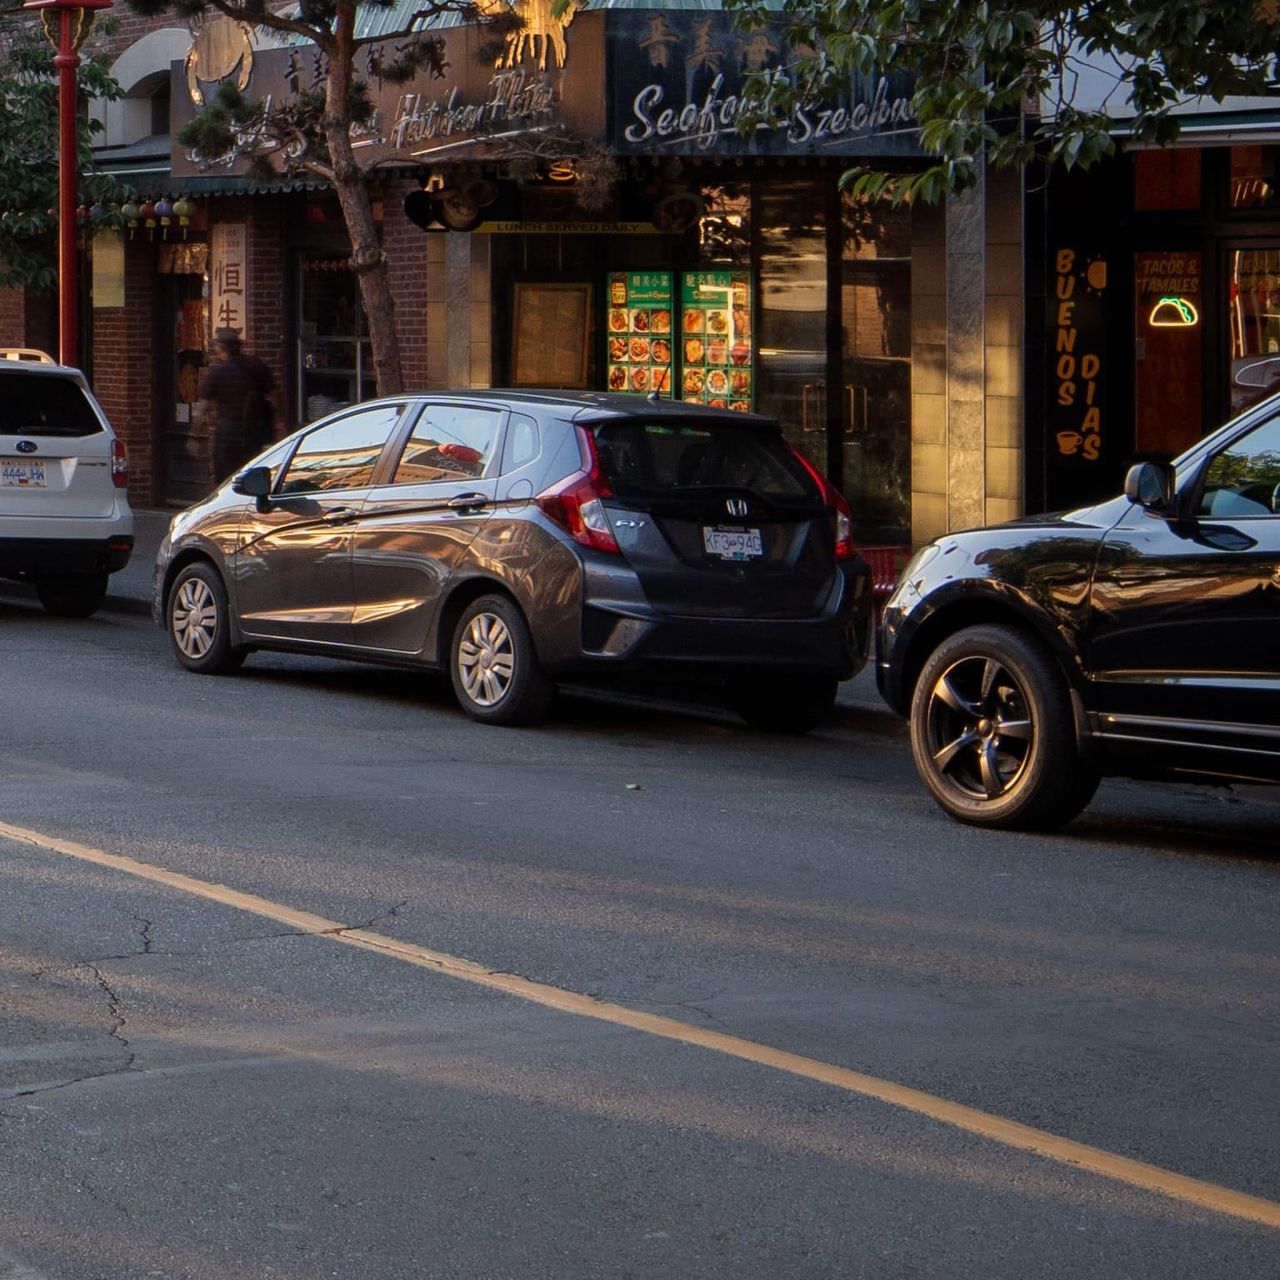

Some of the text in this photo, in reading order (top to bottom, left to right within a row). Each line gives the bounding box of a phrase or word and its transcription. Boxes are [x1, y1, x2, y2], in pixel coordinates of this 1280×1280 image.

[544, 222, 599, 233] SERVED
[601, 222, 643, 233] DAILY
[1141, 277, 1200, 294] TAMALES
[1143, 259, 1185, 276] TACOS
[214, 260, 243, 335] 恒生
[1055, 247, 1078, 407] BUENOS
[1080, 353, 1102, 461] DIAS
